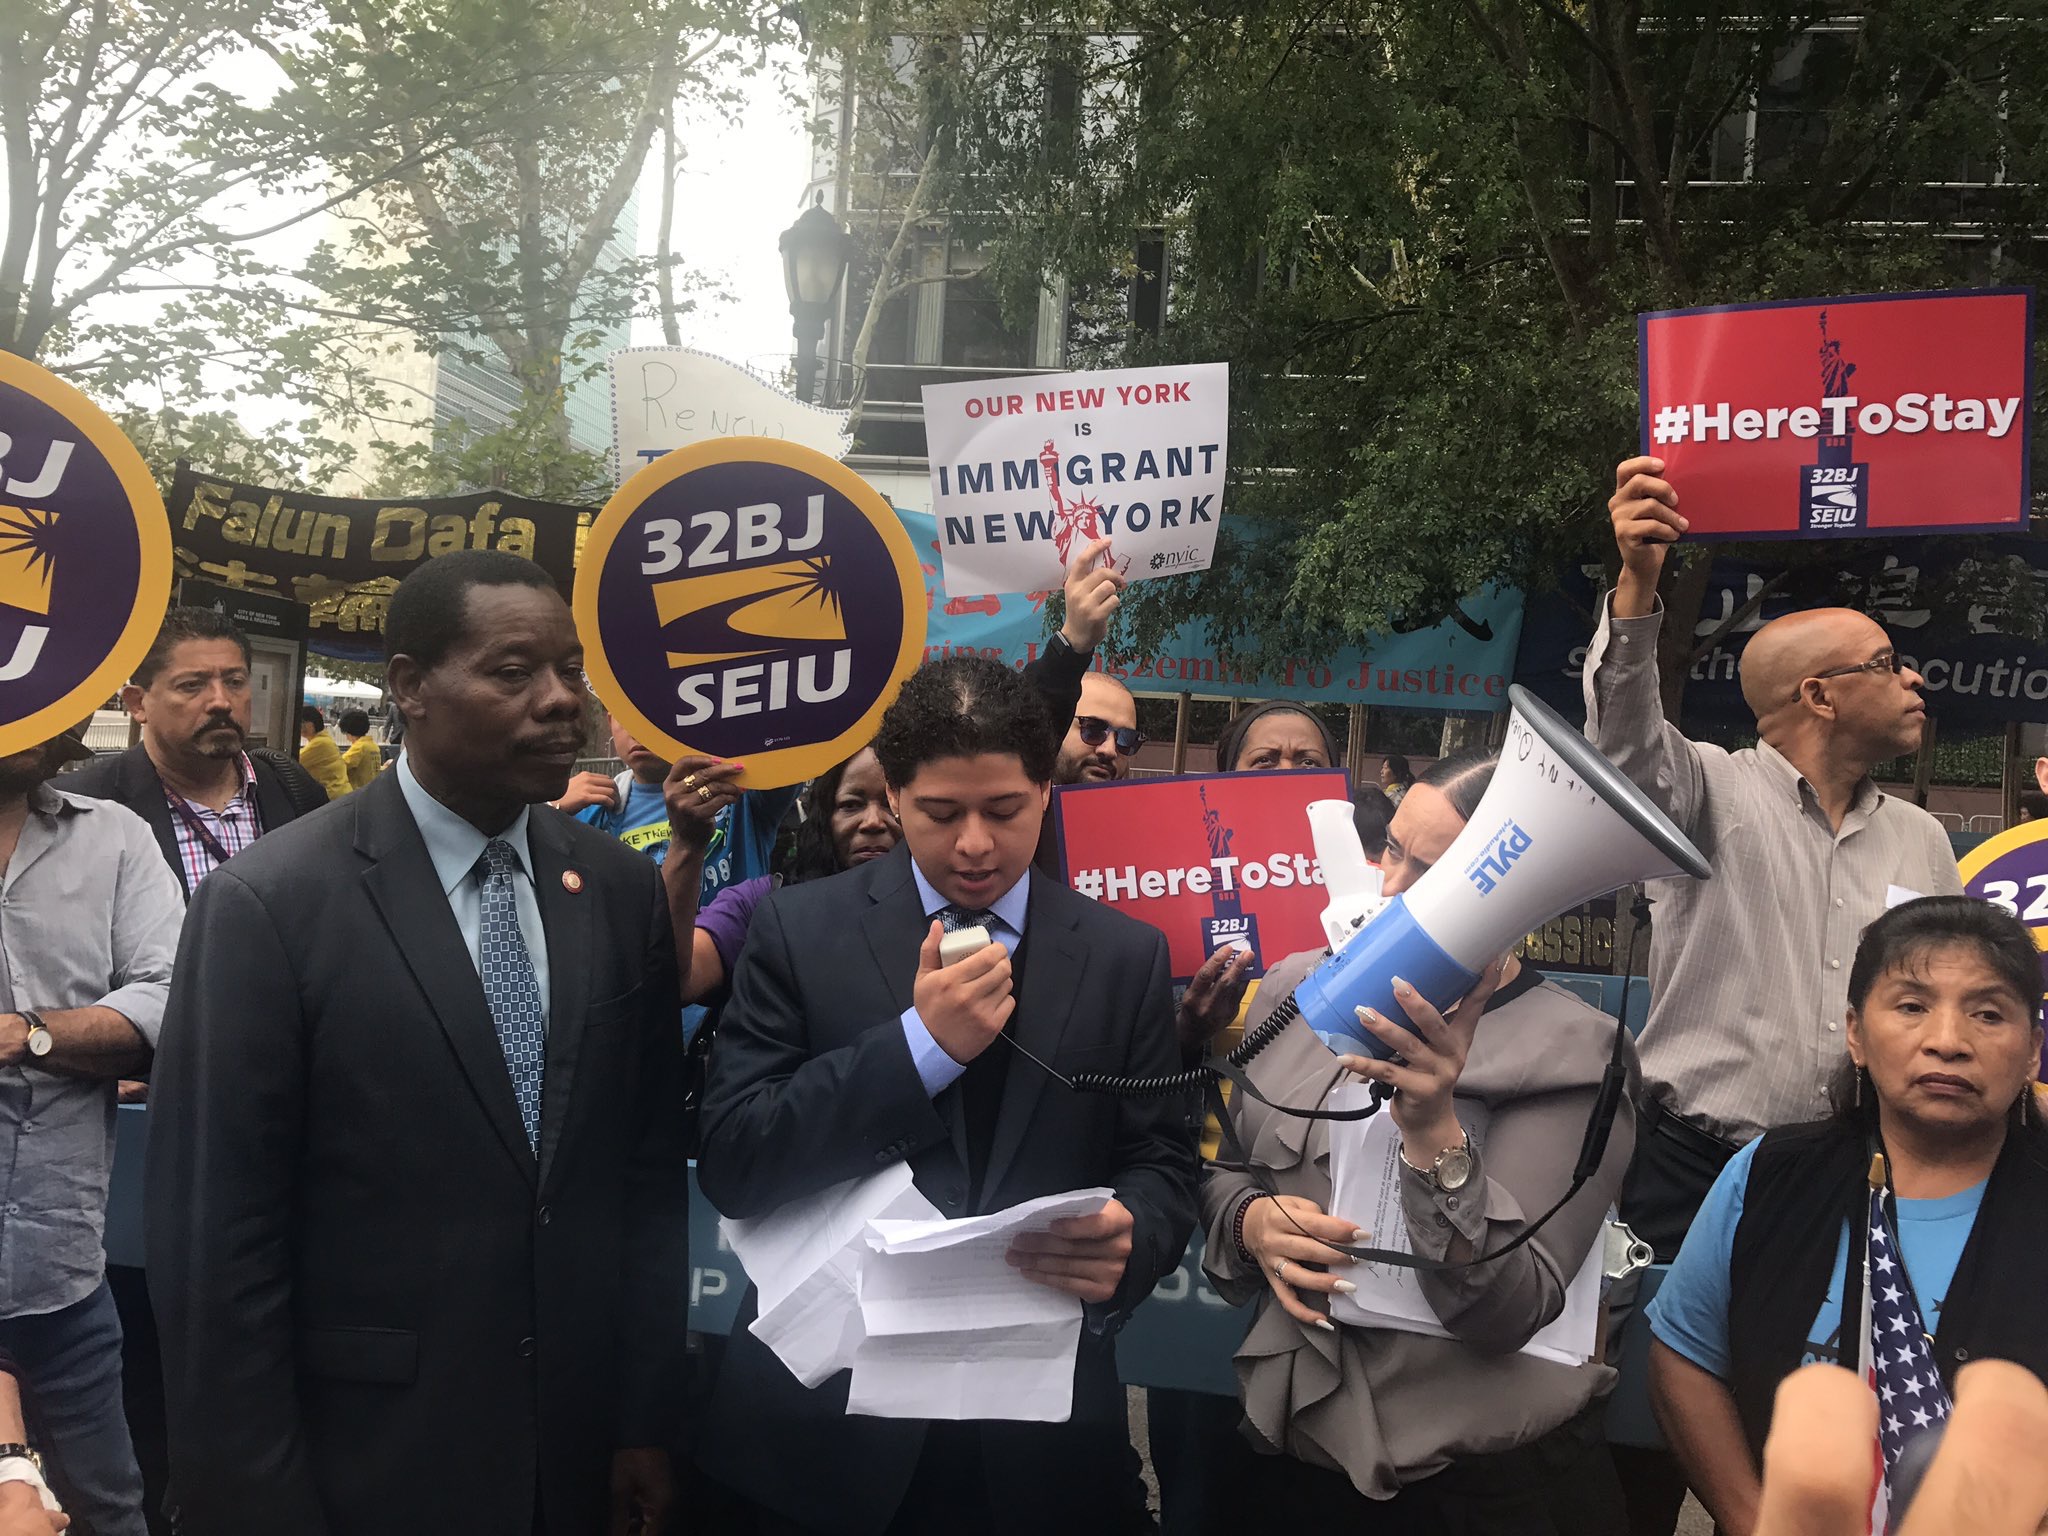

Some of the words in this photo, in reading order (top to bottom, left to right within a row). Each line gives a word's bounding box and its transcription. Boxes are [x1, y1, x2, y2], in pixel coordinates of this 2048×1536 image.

[965, 395, 1023, 418] OUR
[1036, 388, 1105, 413] NEW
[1117, 382, 1191, 406] YORK
[1075, 423, 1092, 437] IS
[1653, 393, 2021, 445] #HereToStay
[1810, 467, 1859, 484] 32BJ
[182, 481, 351, 559] Falun
[371, 501, 536, 562] Dafa
[945, 510, 1054, 545] NEW
[1096, 494, 1214, 535] YORK
[1809, 507, 1857, 523] SEIU
[641, 494, 825, 575] 32BJ
[1165, 545, 1199, 569] nyic
[676, 648, 852, 727] SEIU
[1347, 661, 1506, 698] Justice
[623, 834, 641, 845] KE
[1074, 853, 1326, 902] #HereToSta
[1210, 917, 1249, 933] 32BJ
